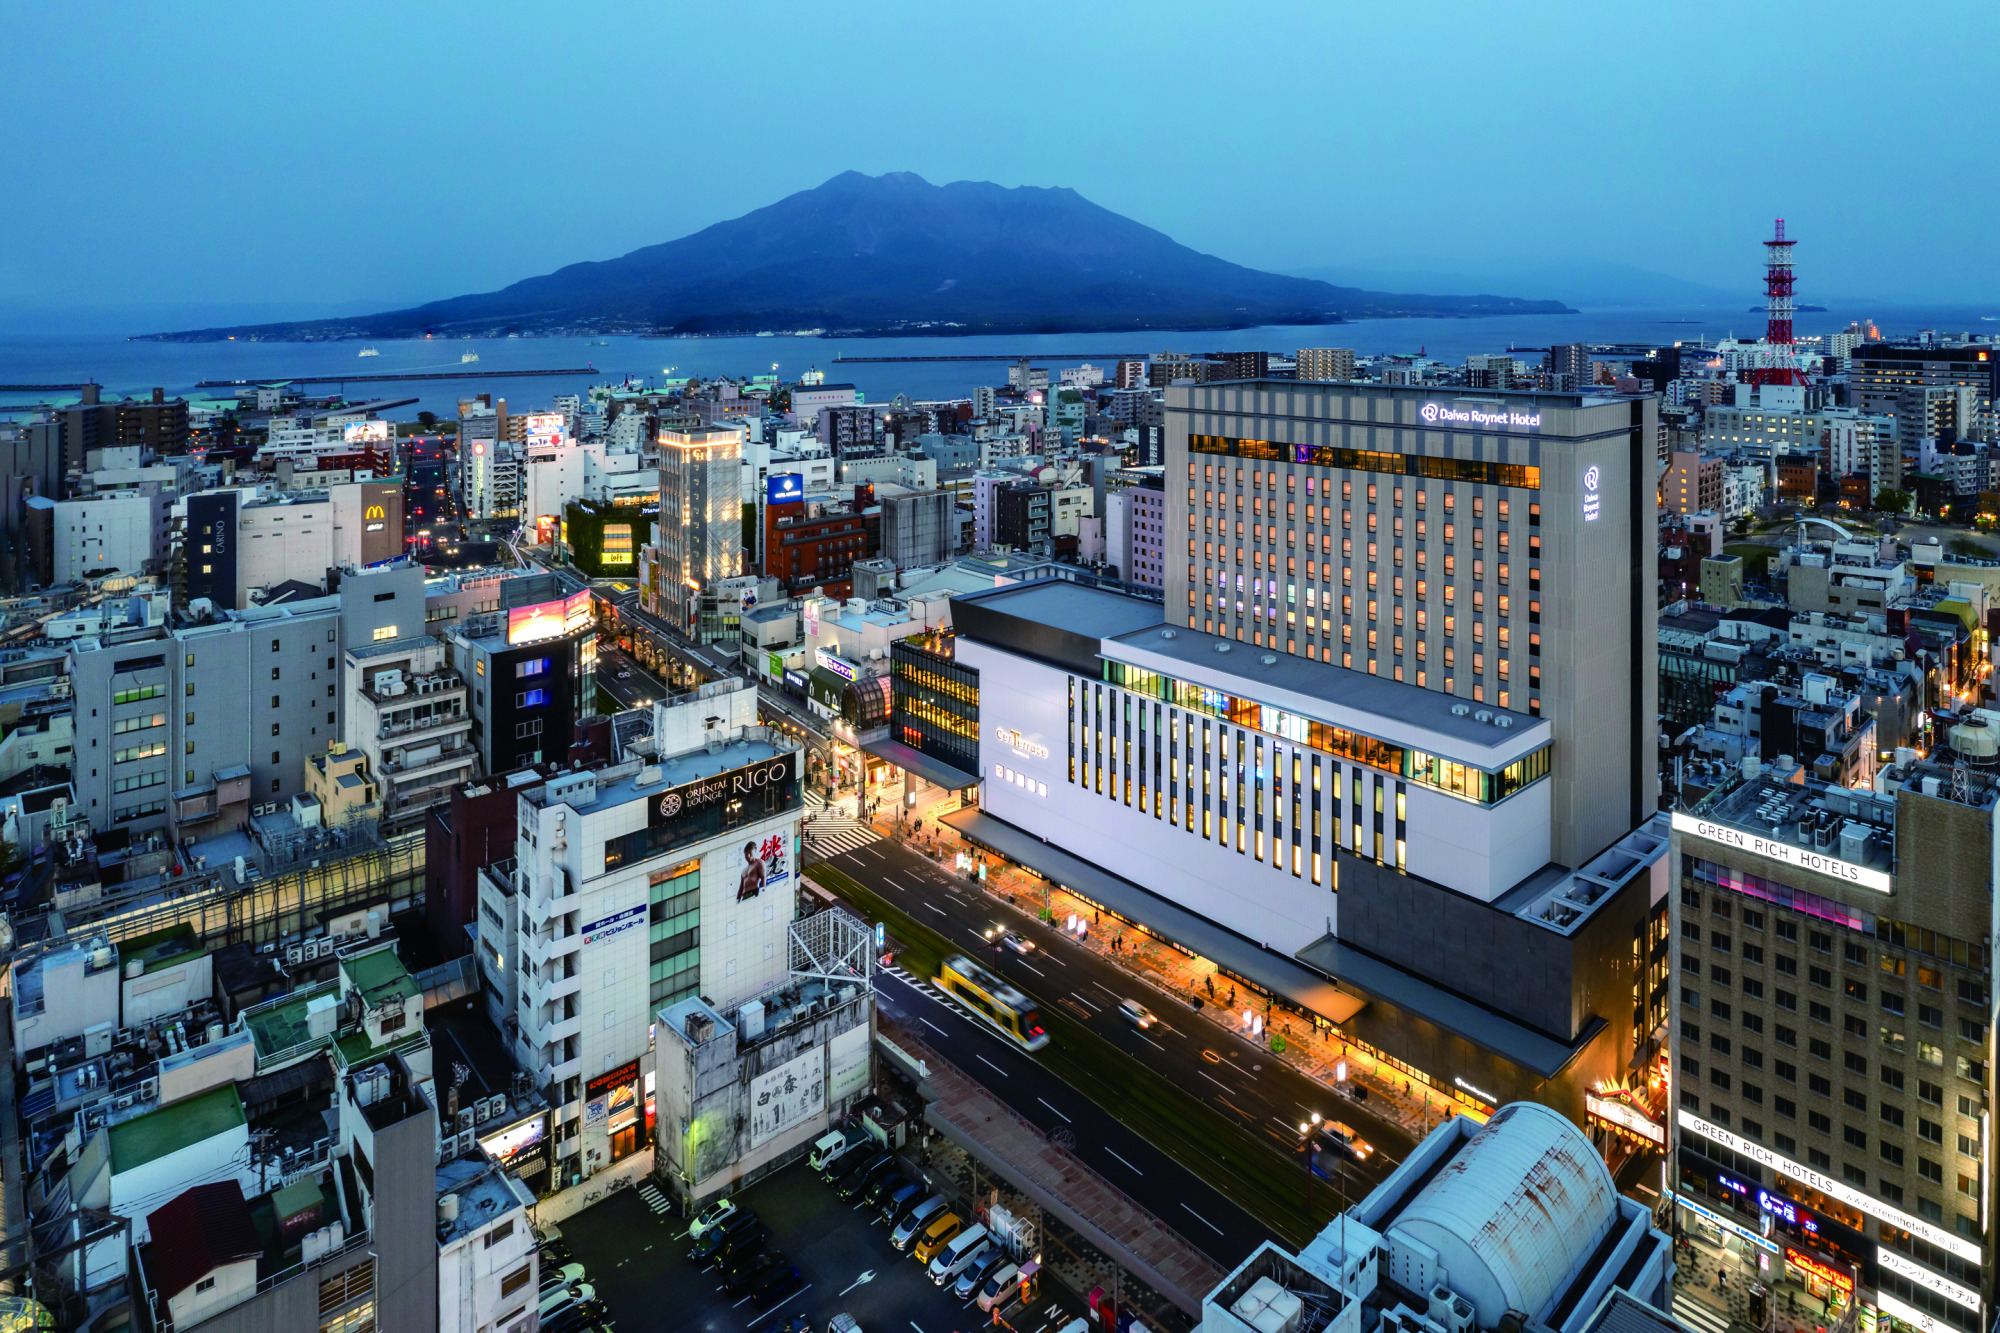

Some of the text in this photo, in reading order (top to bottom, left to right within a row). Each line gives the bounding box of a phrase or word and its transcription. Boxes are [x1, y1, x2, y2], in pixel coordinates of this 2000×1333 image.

[1440, 408, 1469, 421] Daiwa
[1471, 410, 1508, 425] Roynet
[1510, 413, 1540, 426] Hotel
[1584, 493, 1598, 503] Daiwa
[1583, 502, 1599, 513] Roynet
[1585, 511, 1598, 522] Hotel
[216, 520, 225, 554] CARINO
[732, 763, 786, 794] RIGO
[686, 781, 728, 799] ORIENTAL
[687, 790, 722, 808] LOUNGE
[1697, 822, 1858, 880] GREEN RICH HOTELS
[606, 1072, 637, 1090] Coffee
[1693, 1119, 1833, 1192] GREEN RICH HOTELS
[1805, 1220, 1818, 1232] 2F
